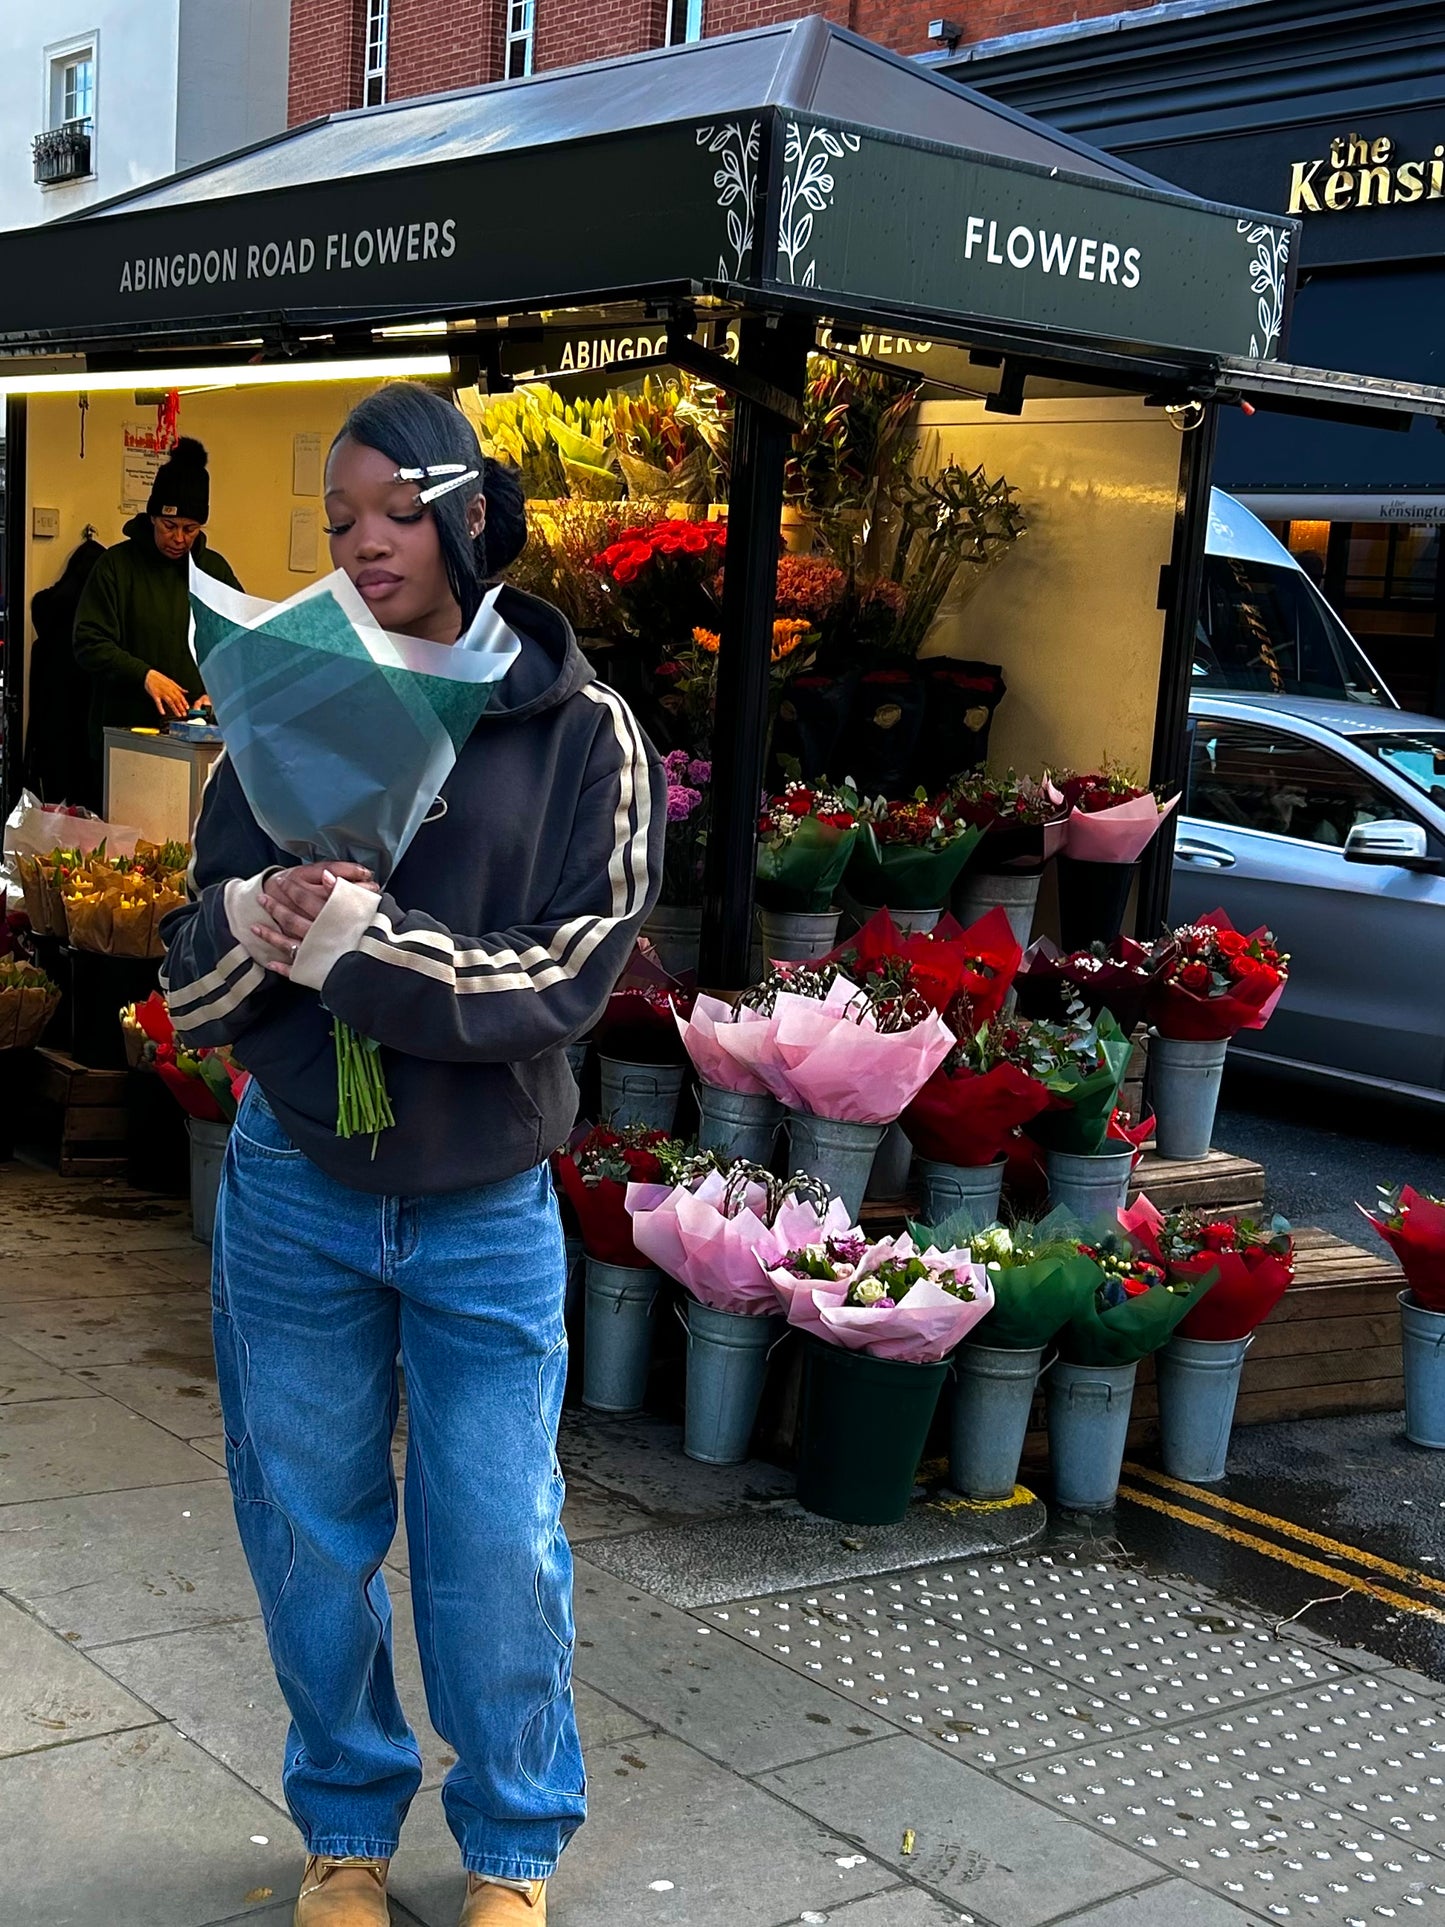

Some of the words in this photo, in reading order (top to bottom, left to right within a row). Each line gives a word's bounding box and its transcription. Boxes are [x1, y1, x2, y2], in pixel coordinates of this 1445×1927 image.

[1285, 144, 1445, 215] Kensi
[1330, 132, 1392, 170] the
[118, 247, 238, 293] ABINGDON
[246, 238, 316, 280] ROAD
[325, 218, 457, 271] FLOWERS
[964, 215, 1142, 289] FLOWERS
